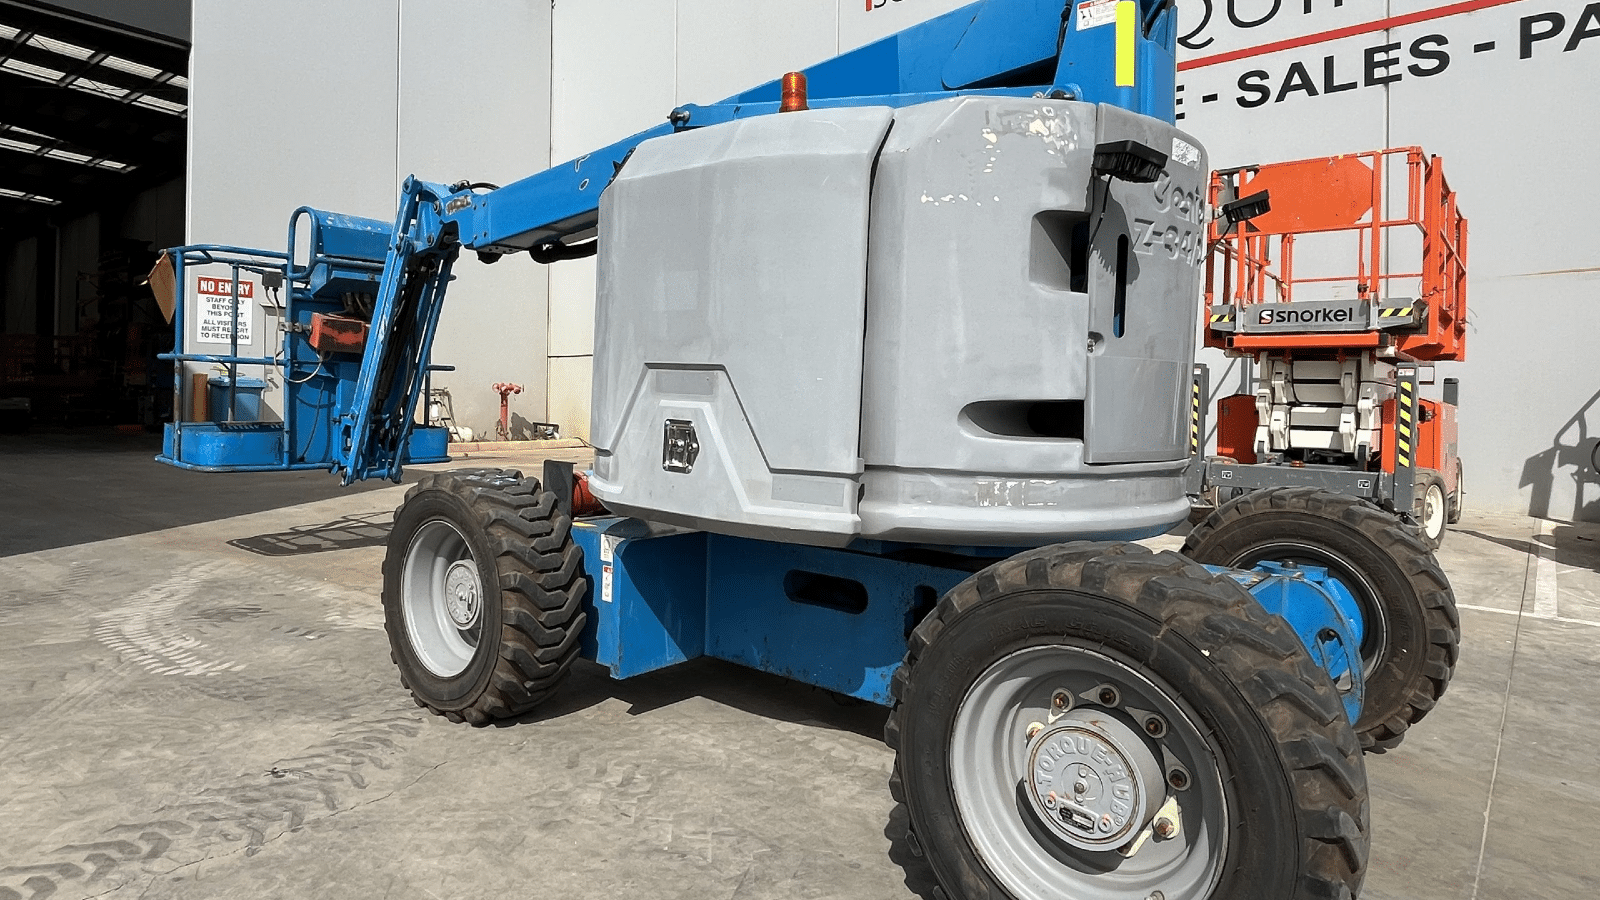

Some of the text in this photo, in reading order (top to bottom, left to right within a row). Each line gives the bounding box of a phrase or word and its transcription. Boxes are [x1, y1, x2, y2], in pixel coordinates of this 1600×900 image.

[1236, 33, 1451, 109] SALES
[200, 280, 250, 295] NO ENRY
[1276, 307, 1353, 322] snorkel
